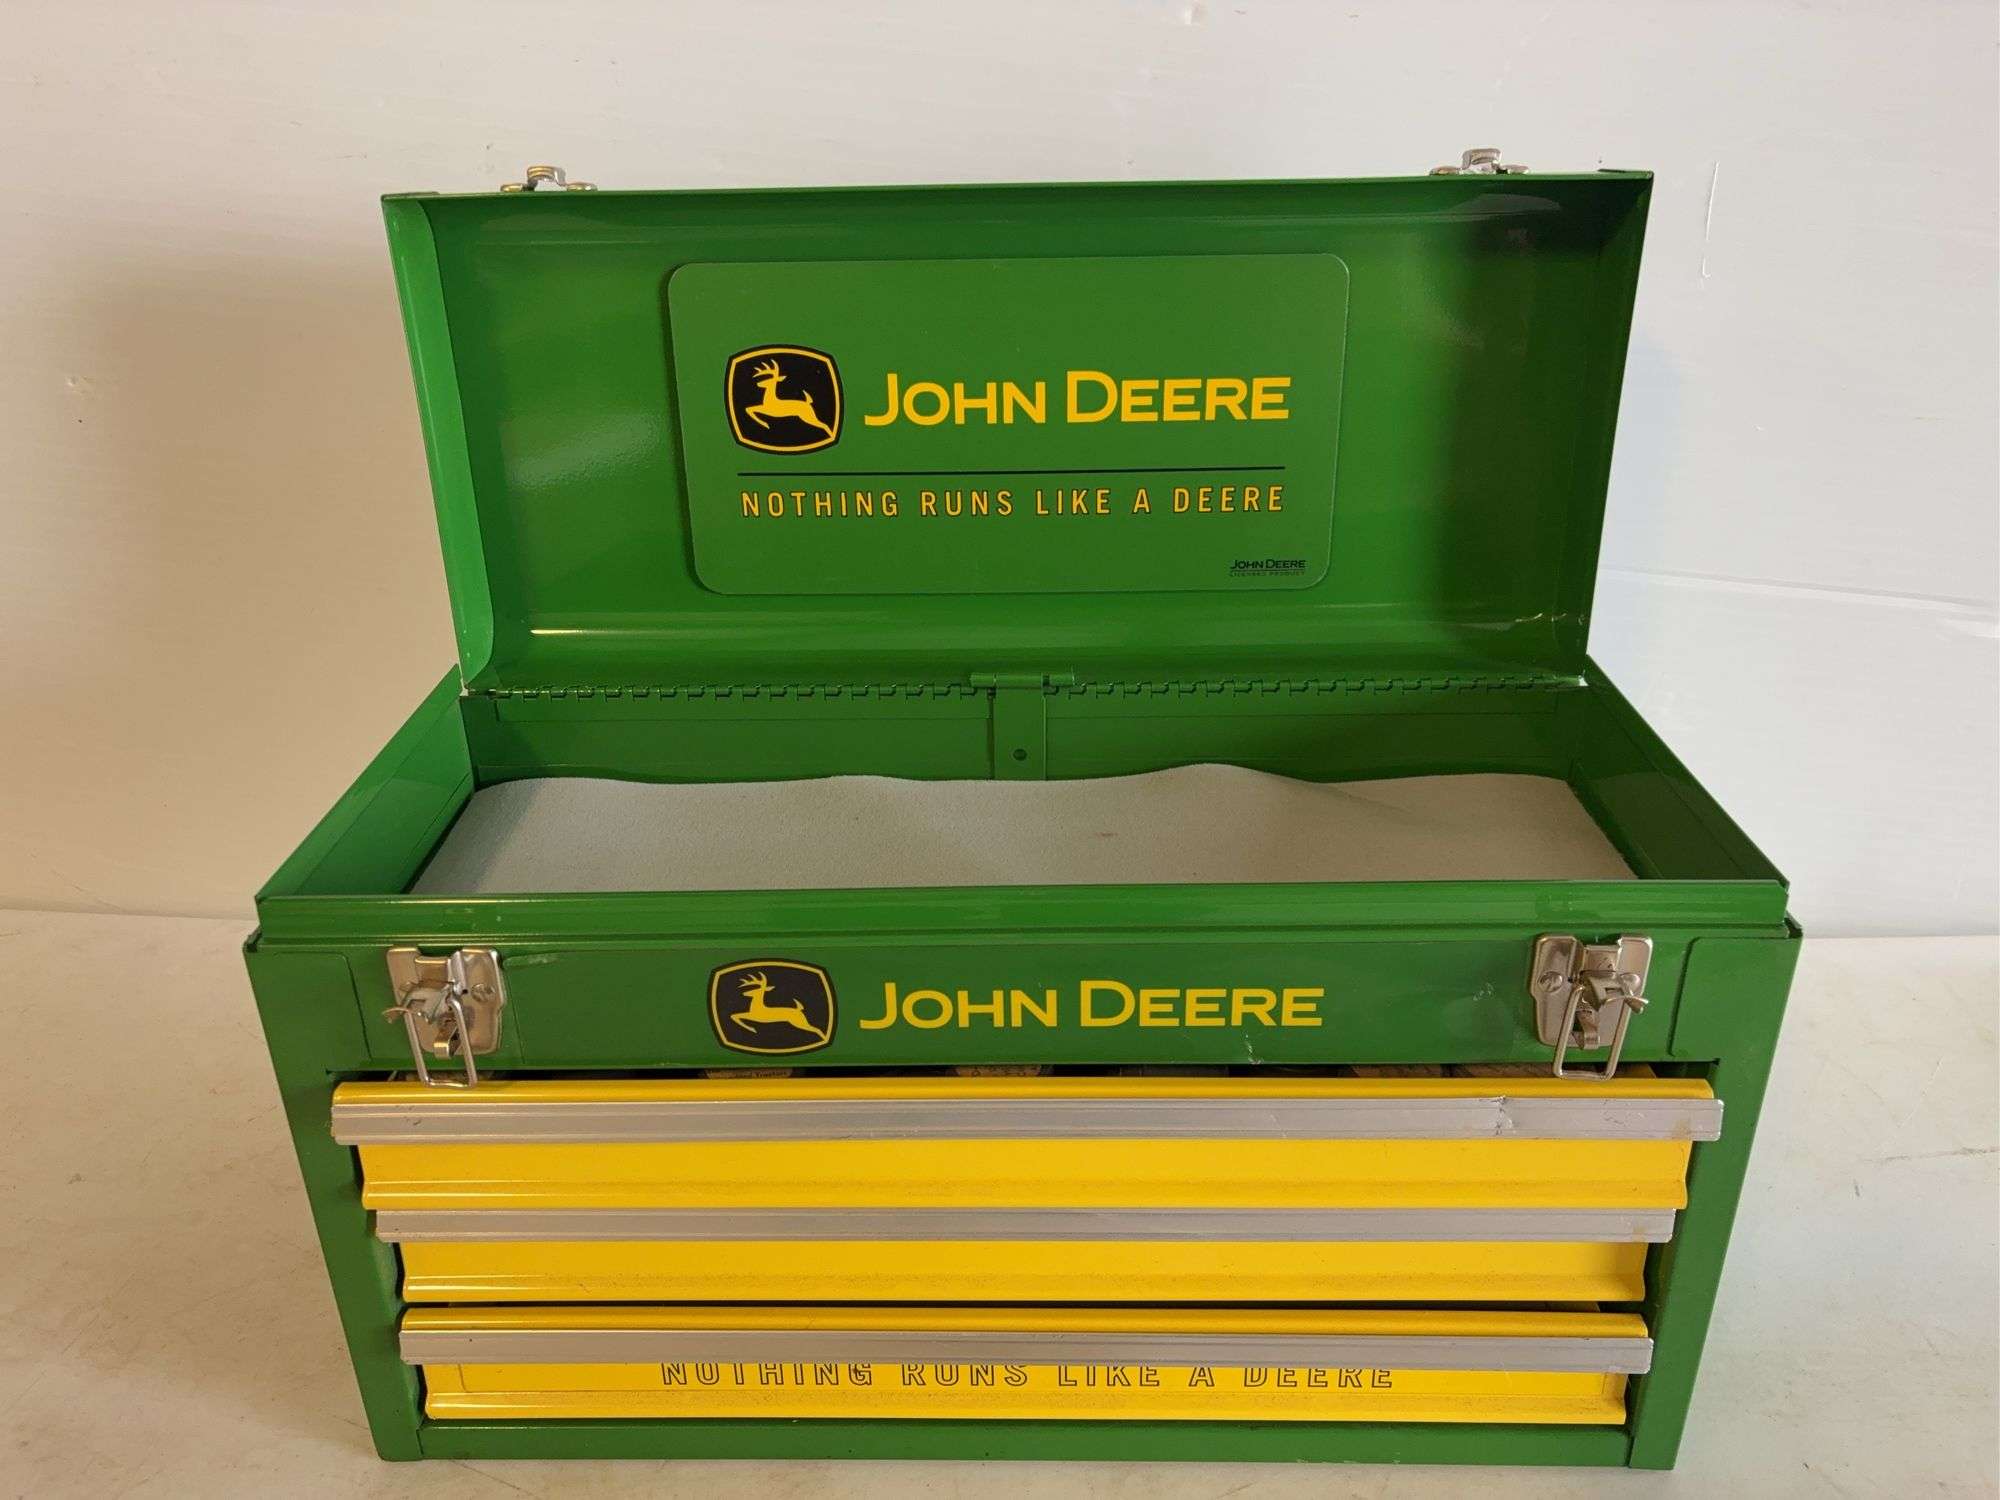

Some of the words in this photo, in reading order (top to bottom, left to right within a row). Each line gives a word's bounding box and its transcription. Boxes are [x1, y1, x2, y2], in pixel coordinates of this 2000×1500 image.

[864, 372, 1046, 427] JOHN
[1066, 370, 1292, 424] DEERE
[741, 490, 899, 518] NOTHING
[920, 489, 1013, 517] RUNS
[1035, 488, 1111, 516] LIKE
[1132, 487, 1151, 515] A
[1174, 486, 1283, 514] DEERE
[1230, 559, 1264, 569] JOHN
[1265, 558, 1306, 569] DEERE
[859, 982, 1058, 1029] JOHN
[1080, 980, 1325, 1027] DEERE
[901, 1364, 1028, 1387] RUNS
[1057, 1366, 1160, 1387] LIKE
[1188, 1367, 1215, 1387] A
[1243, 1368, 1393, 1389] DEERE
